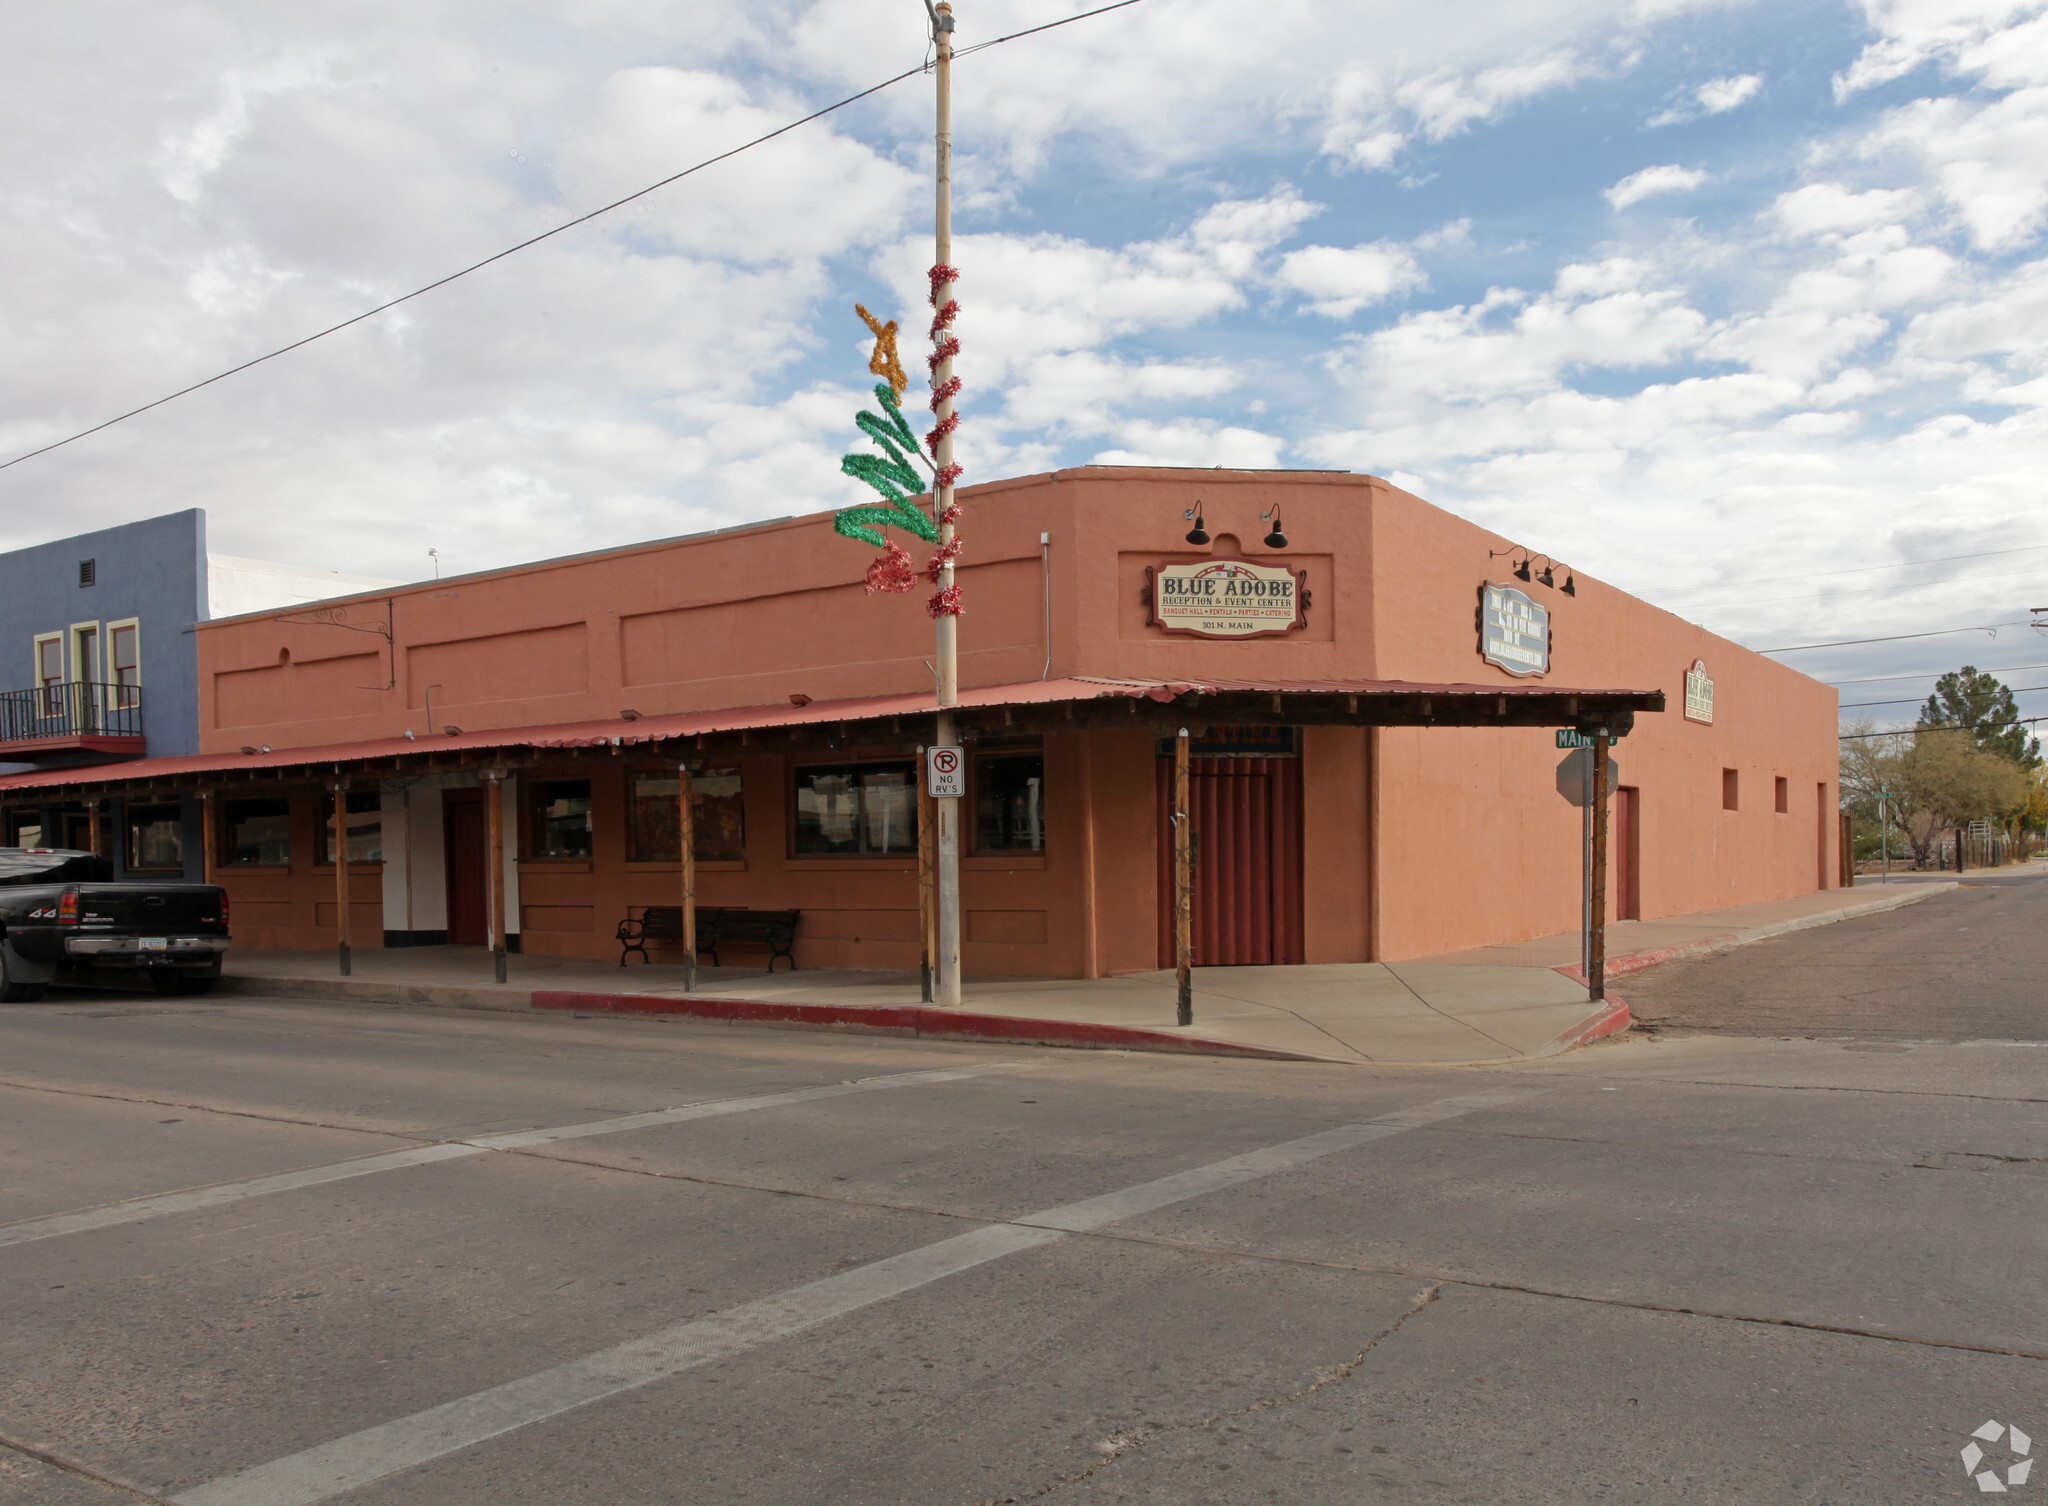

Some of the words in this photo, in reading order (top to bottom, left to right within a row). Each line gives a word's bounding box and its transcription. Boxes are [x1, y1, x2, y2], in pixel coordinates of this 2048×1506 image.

[1163, 578, 1216, 595] BLUE
[1224, 580, 1293, 597] ADOBE
[1162, 597, 1212, 605] RECEPTION
[1559, 730, 1591, 747] MAIN
[940, 775, 953, 784] NO
[935, 785, 958, 793] RV'S
